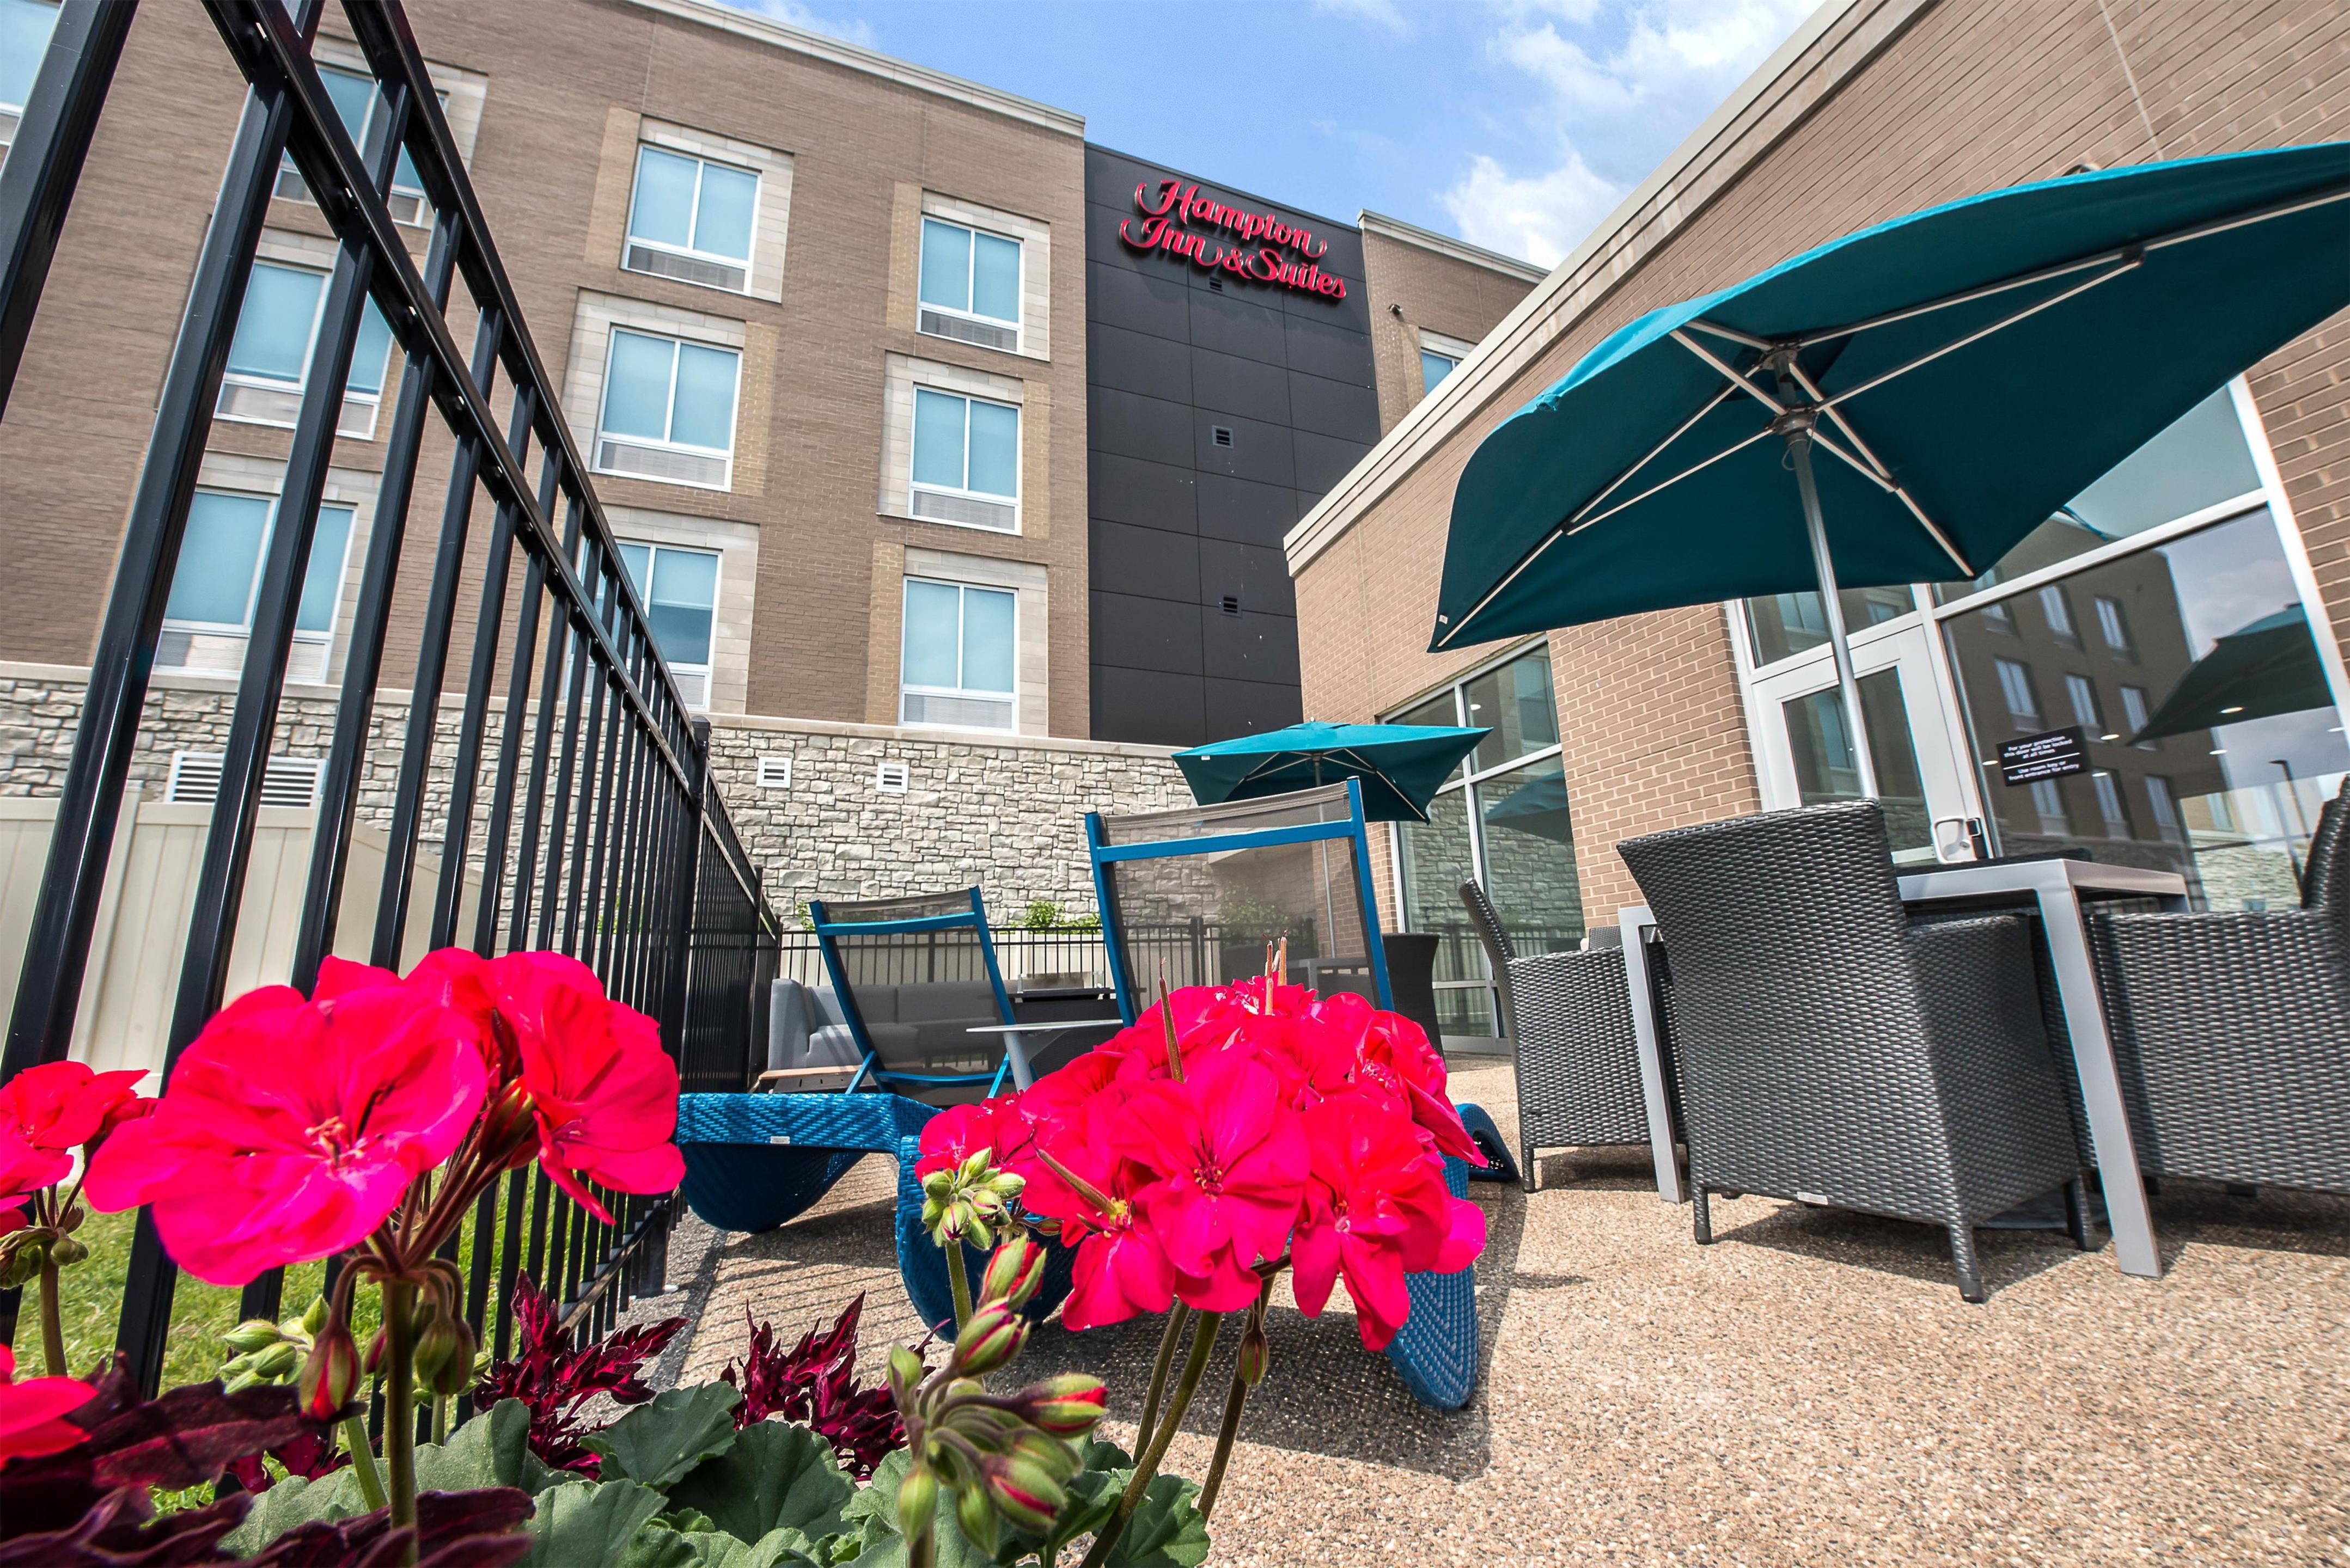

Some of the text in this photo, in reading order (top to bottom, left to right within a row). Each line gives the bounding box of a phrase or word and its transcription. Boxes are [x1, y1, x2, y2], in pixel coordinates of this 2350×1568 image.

[1136, 179, 1327, 258] Hampton
[1120, 217, 1346, 299] Inn & Suites
[2034, 736, 2065, 747] protection
[2052, 739, 2073, 748] locked
[2024, 769, 2051, 777] entrance
